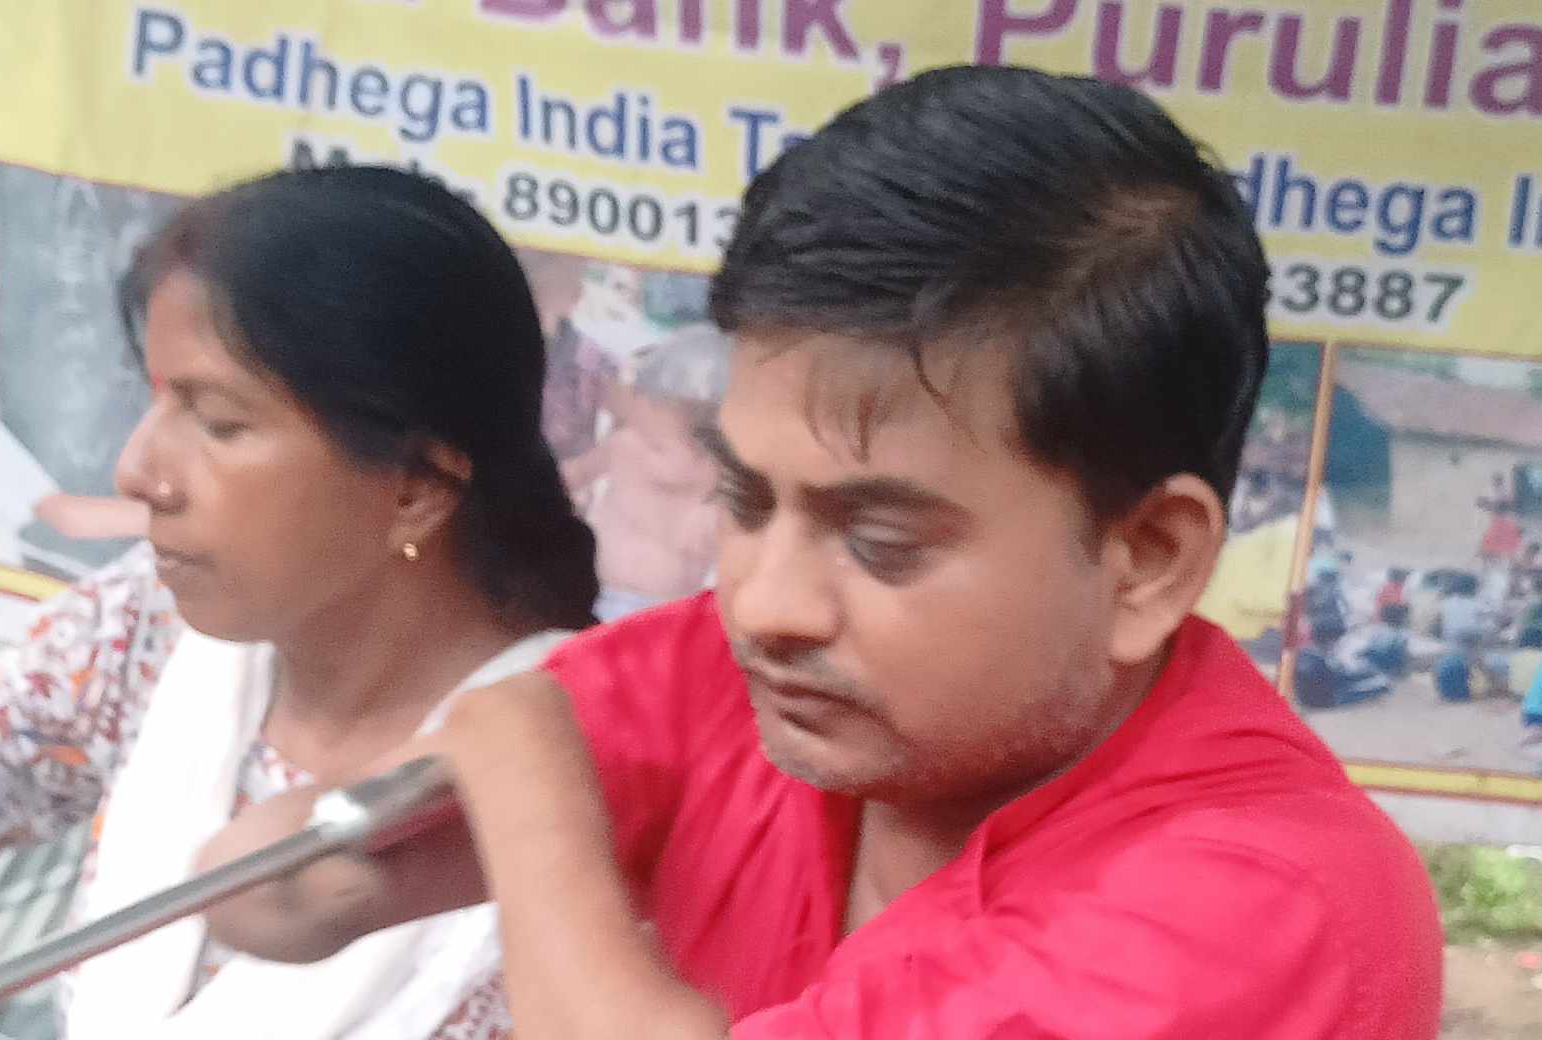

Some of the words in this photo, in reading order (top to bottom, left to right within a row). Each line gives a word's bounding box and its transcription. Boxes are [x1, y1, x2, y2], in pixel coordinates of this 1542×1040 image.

[133, 9, 488, 142] Padhega
[516, 74, 697, 168] India
[729, 107, 811, 178] T
[1227, 153, 1477, 256] dhega
[1263, 262, 1465, 322] 3887
